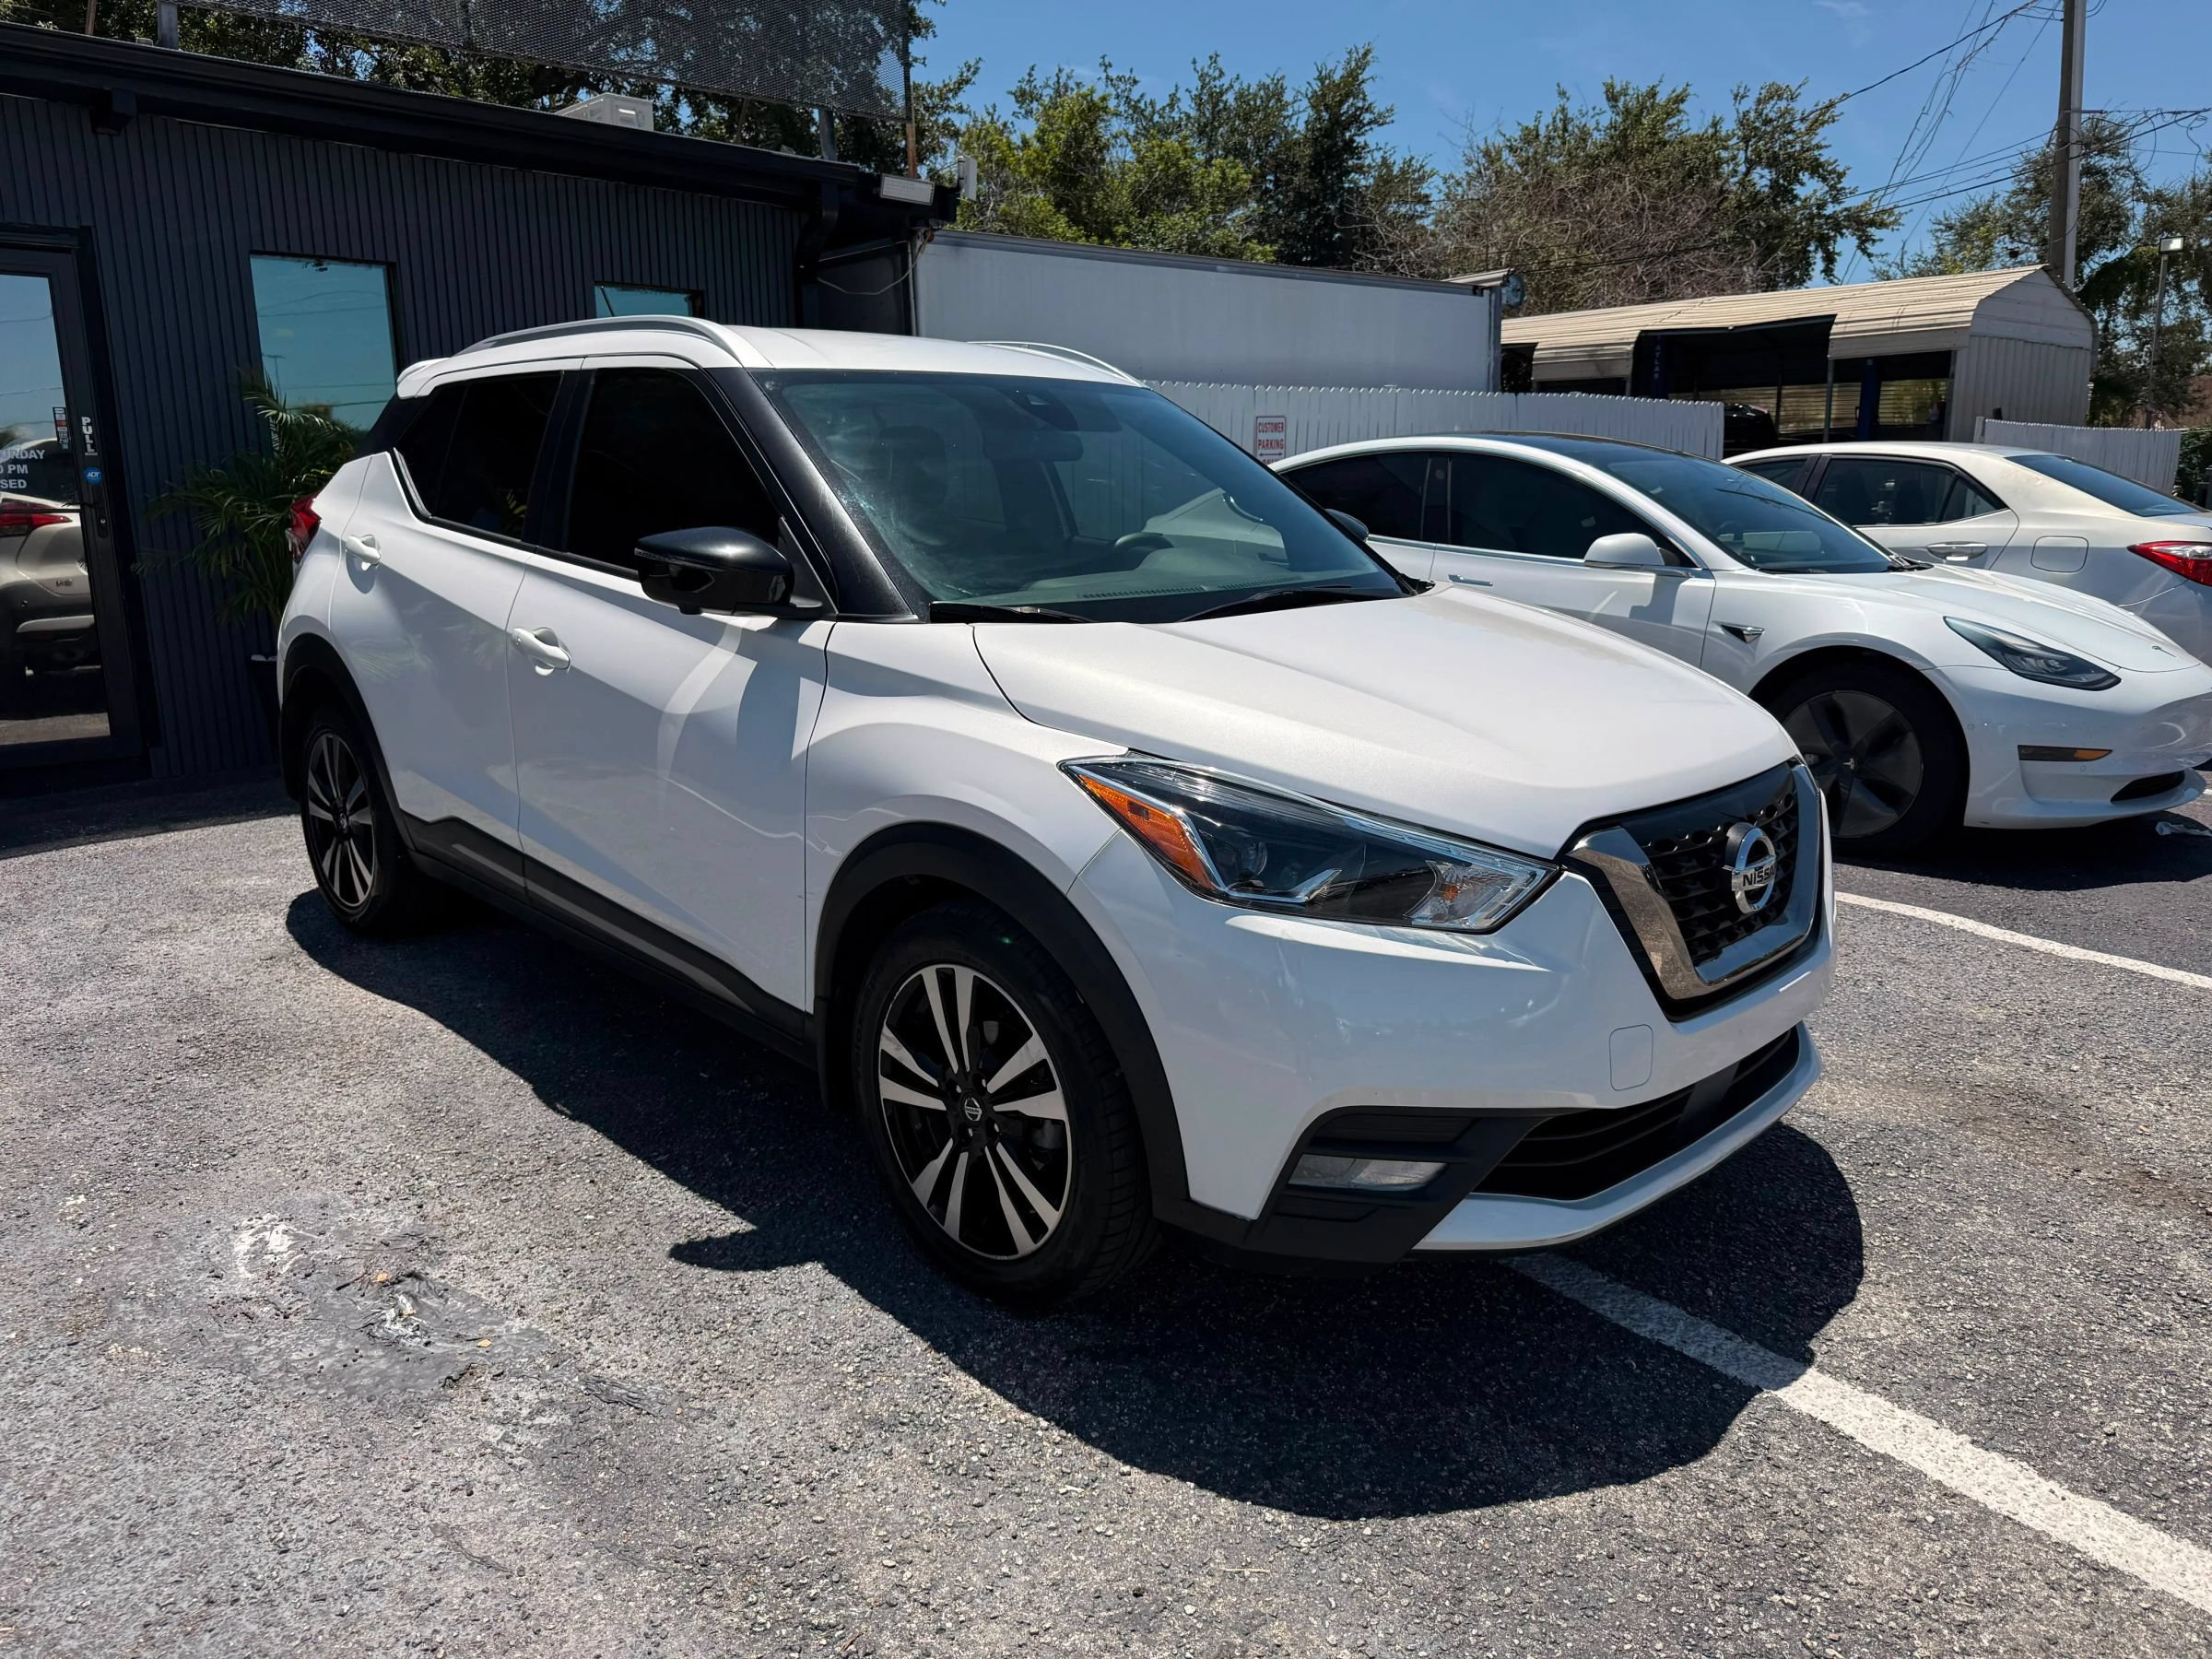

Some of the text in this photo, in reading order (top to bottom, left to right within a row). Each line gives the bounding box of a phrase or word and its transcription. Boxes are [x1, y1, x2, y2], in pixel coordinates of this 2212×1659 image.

[1258, 422, 1284, 433] CUSTOMER
[81, 417, 95, 453] PULL
[1258, 439, 1283, 450] PARKING
[7, 464, 29, 474] PM
[0, 479, 27, 488] SED
